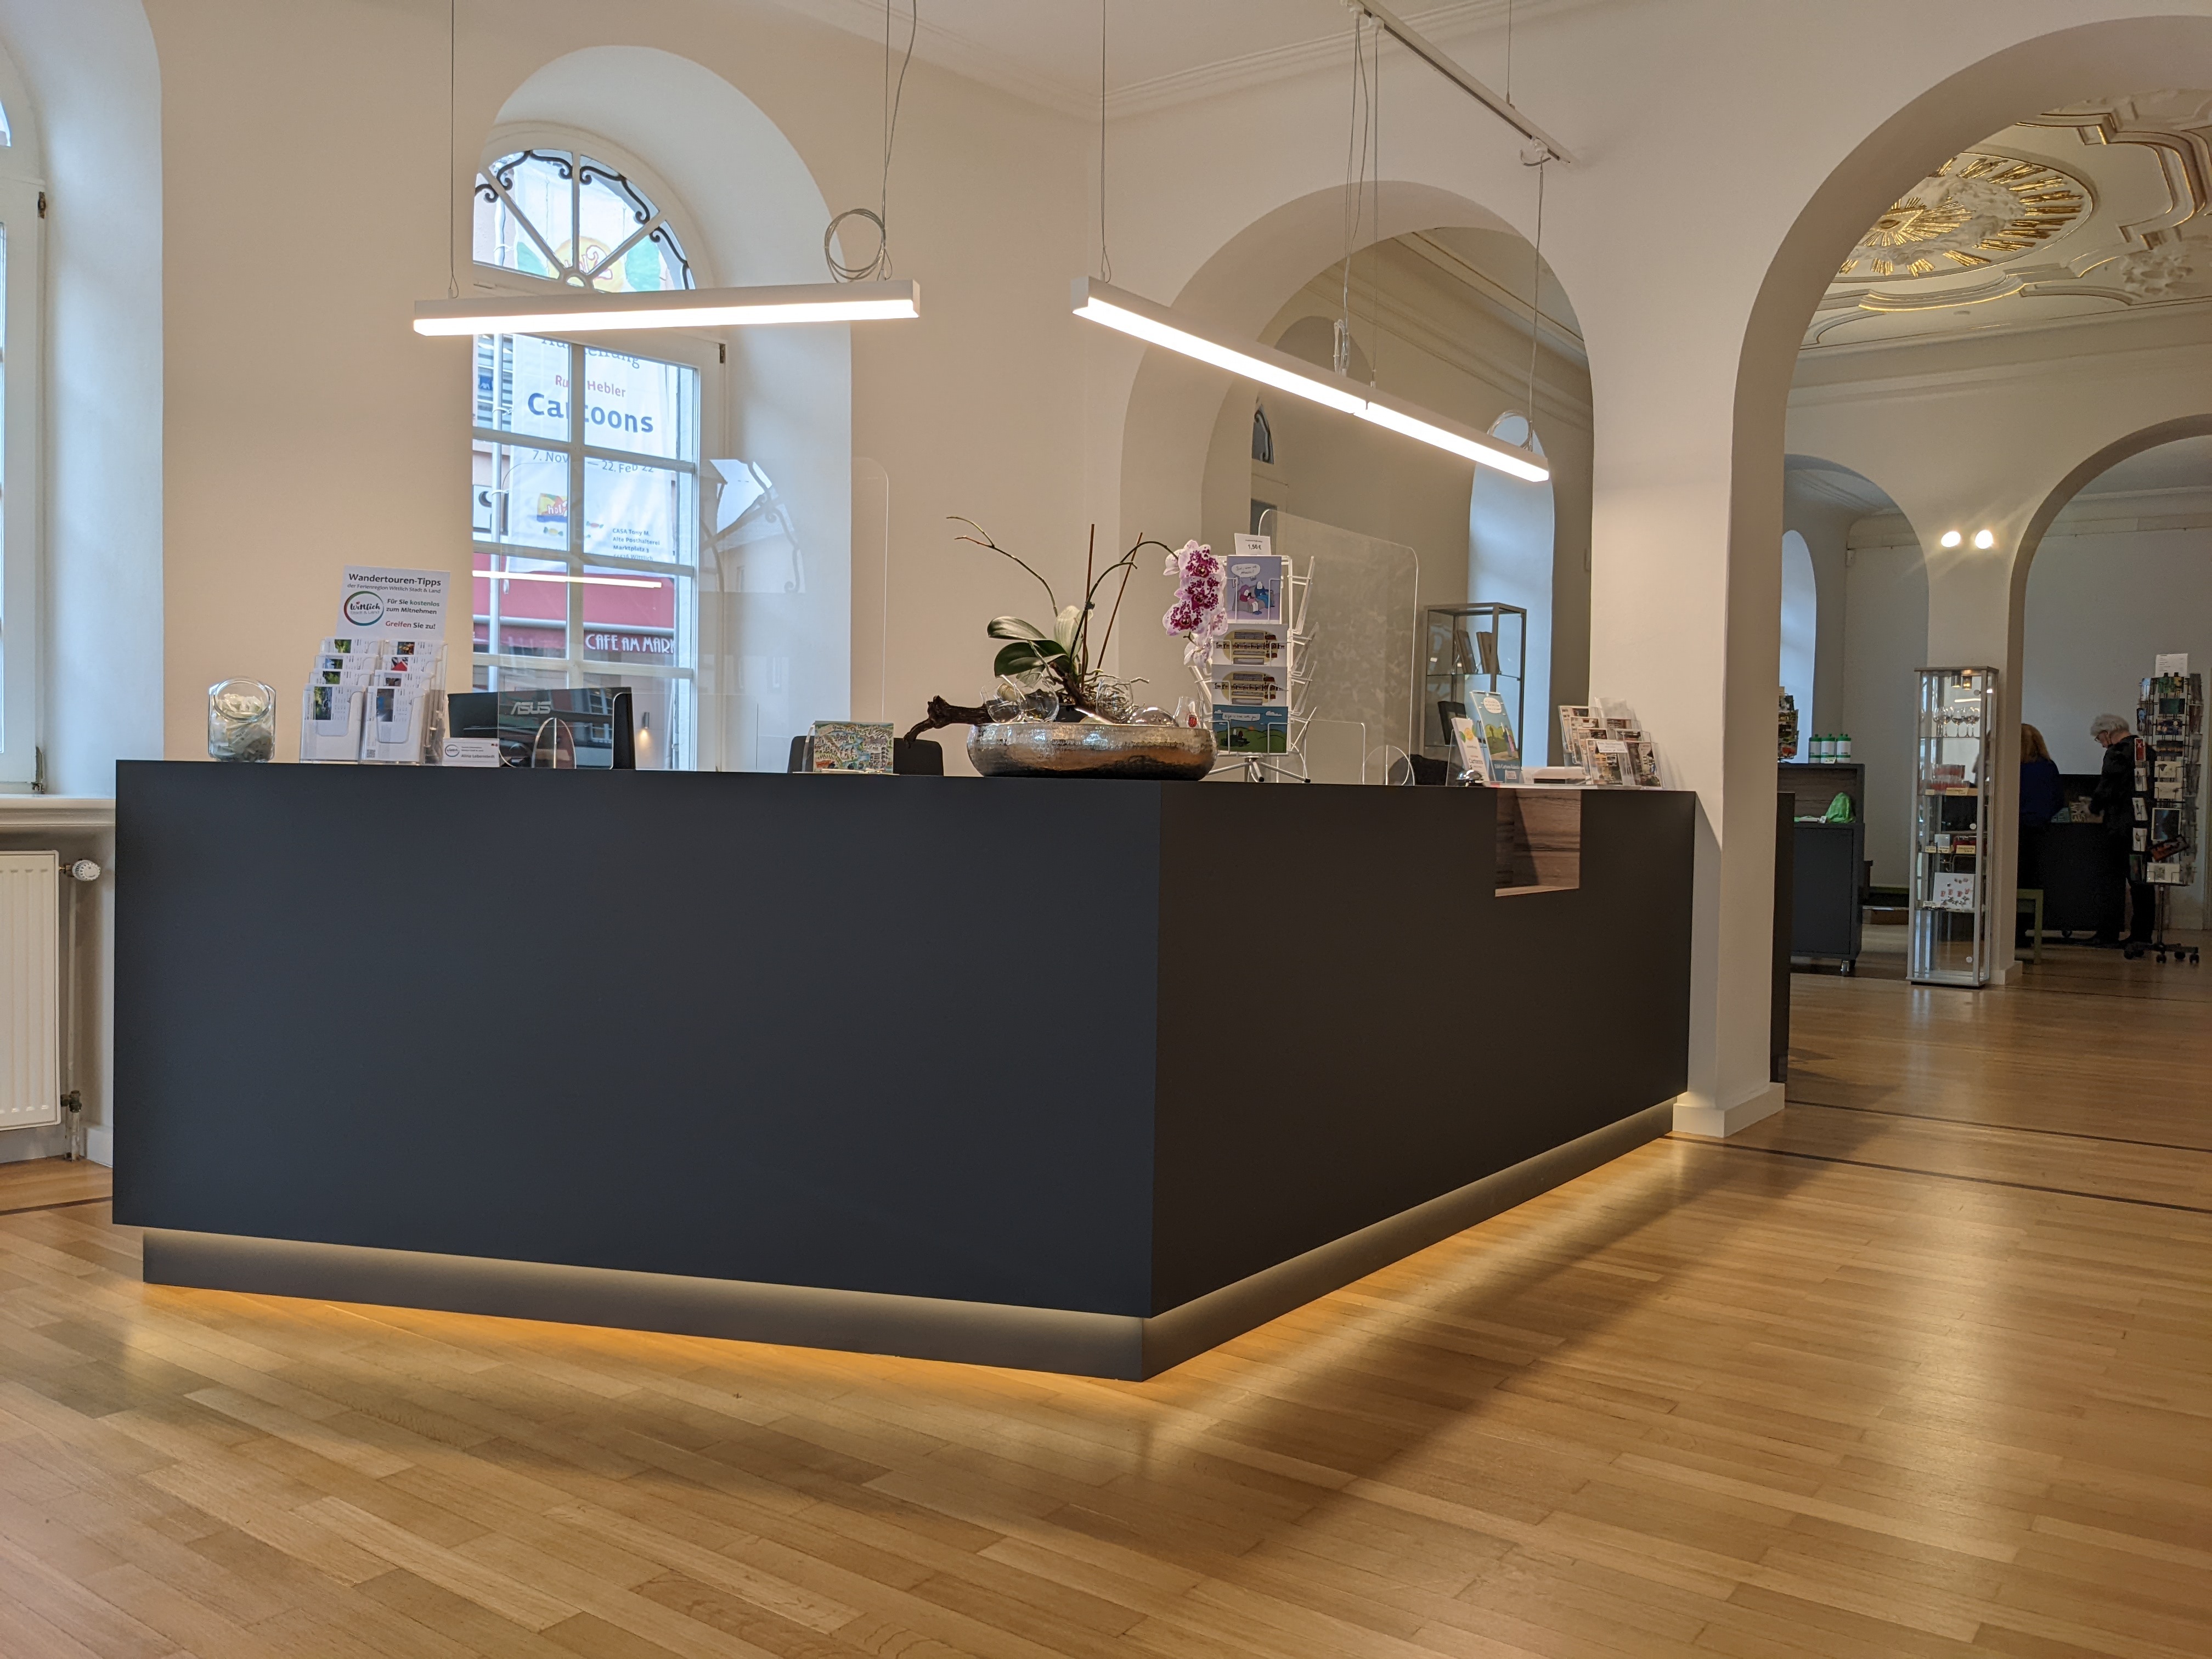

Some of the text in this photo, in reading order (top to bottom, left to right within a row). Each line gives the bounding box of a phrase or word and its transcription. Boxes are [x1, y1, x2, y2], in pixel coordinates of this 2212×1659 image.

[555, 375, 626, 398] Ru Hebler
[533, 450, 542, 461] 7.
[602, 460, 616, 472] 22.
[348, 573, 441, 587] Wandertouren-Tipps
[350, 602, 380, 611] Wittlich
[585, 634, 619, 651] CAFE
[621, 637, 640, 652] AM
[511, 701, 551, 715] ASUS
